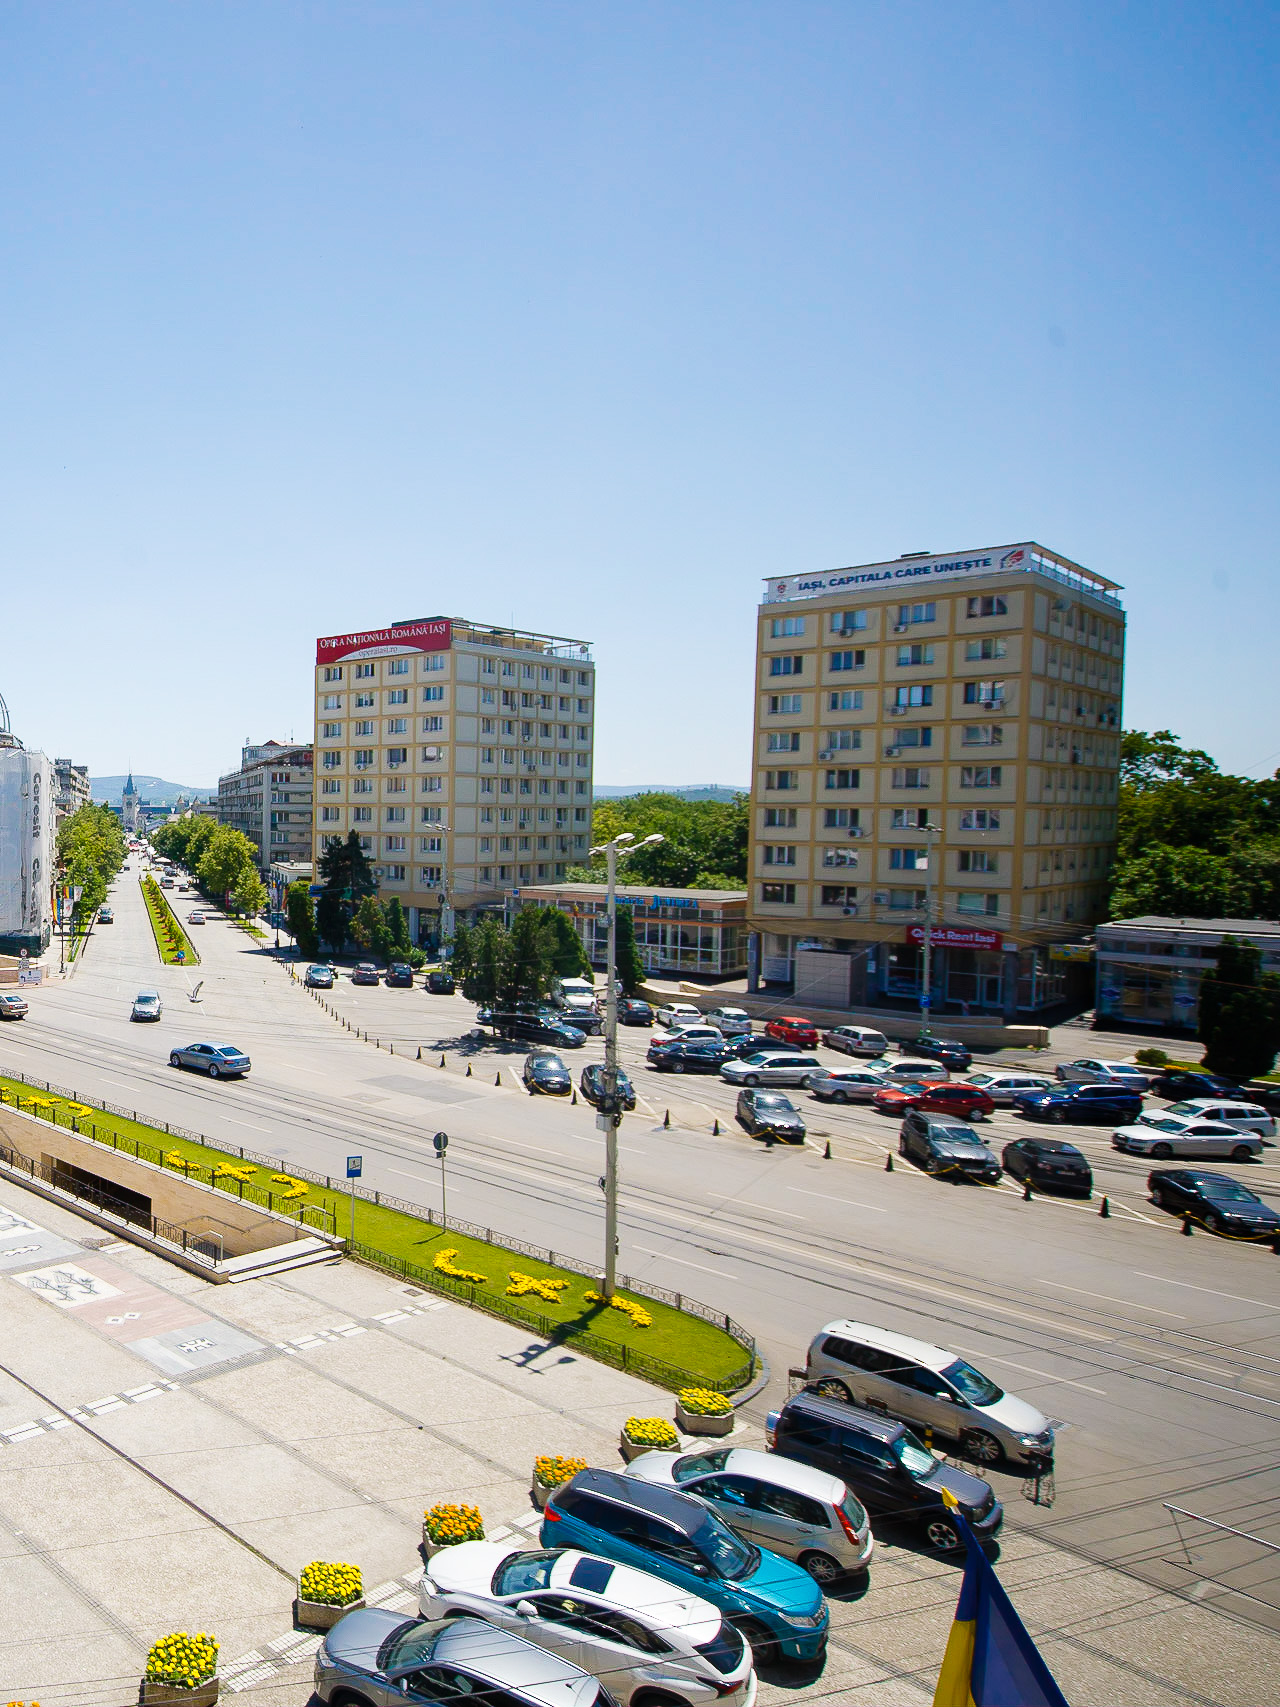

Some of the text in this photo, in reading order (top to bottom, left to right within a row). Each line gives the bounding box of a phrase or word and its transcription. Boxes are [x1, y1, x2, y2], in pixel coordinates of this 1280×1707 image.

[798, 557, 993, 592] IAȘI, CAPITALA CARE UNEȘTE
[33, 772, 41, 838] Ceresit
